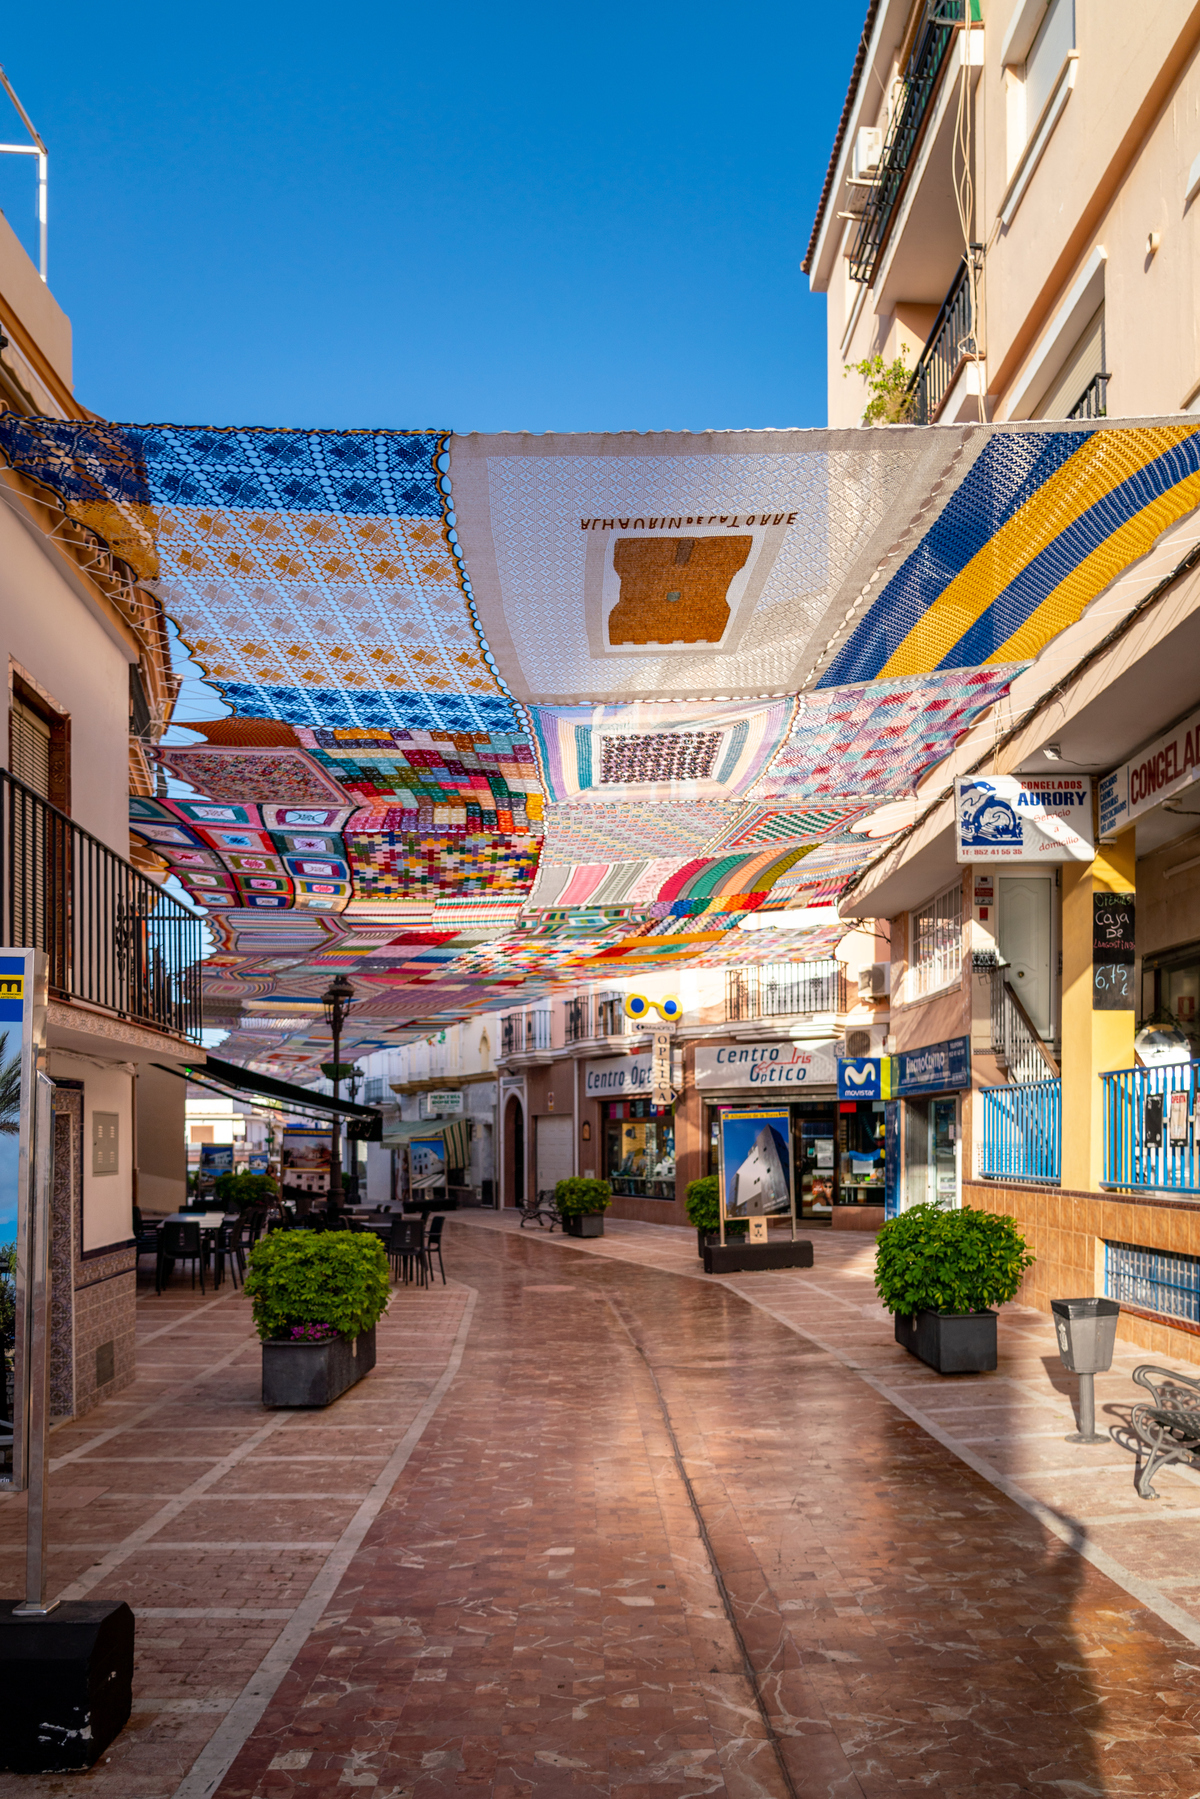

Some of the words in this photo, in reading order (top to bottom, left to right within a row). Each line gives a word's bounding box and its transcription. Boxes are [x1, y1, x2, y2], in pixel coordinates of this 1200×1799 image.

[1021, 780, 1083, 790] CONGELADOS
[1017, 791, 1087, 806] AURORY
[1033, 808, 1071, 824] Servicio
[1038, 836, 1080, 852] domicilio
[1095, 910, 1129, 929] Caja
[716, 1047, 779, 1064] Centro
[791, 1047, 812, 1064] Iris
[587, 1070, 625, 1089] Centro
[844, 1089, 875, 1097] movistar
